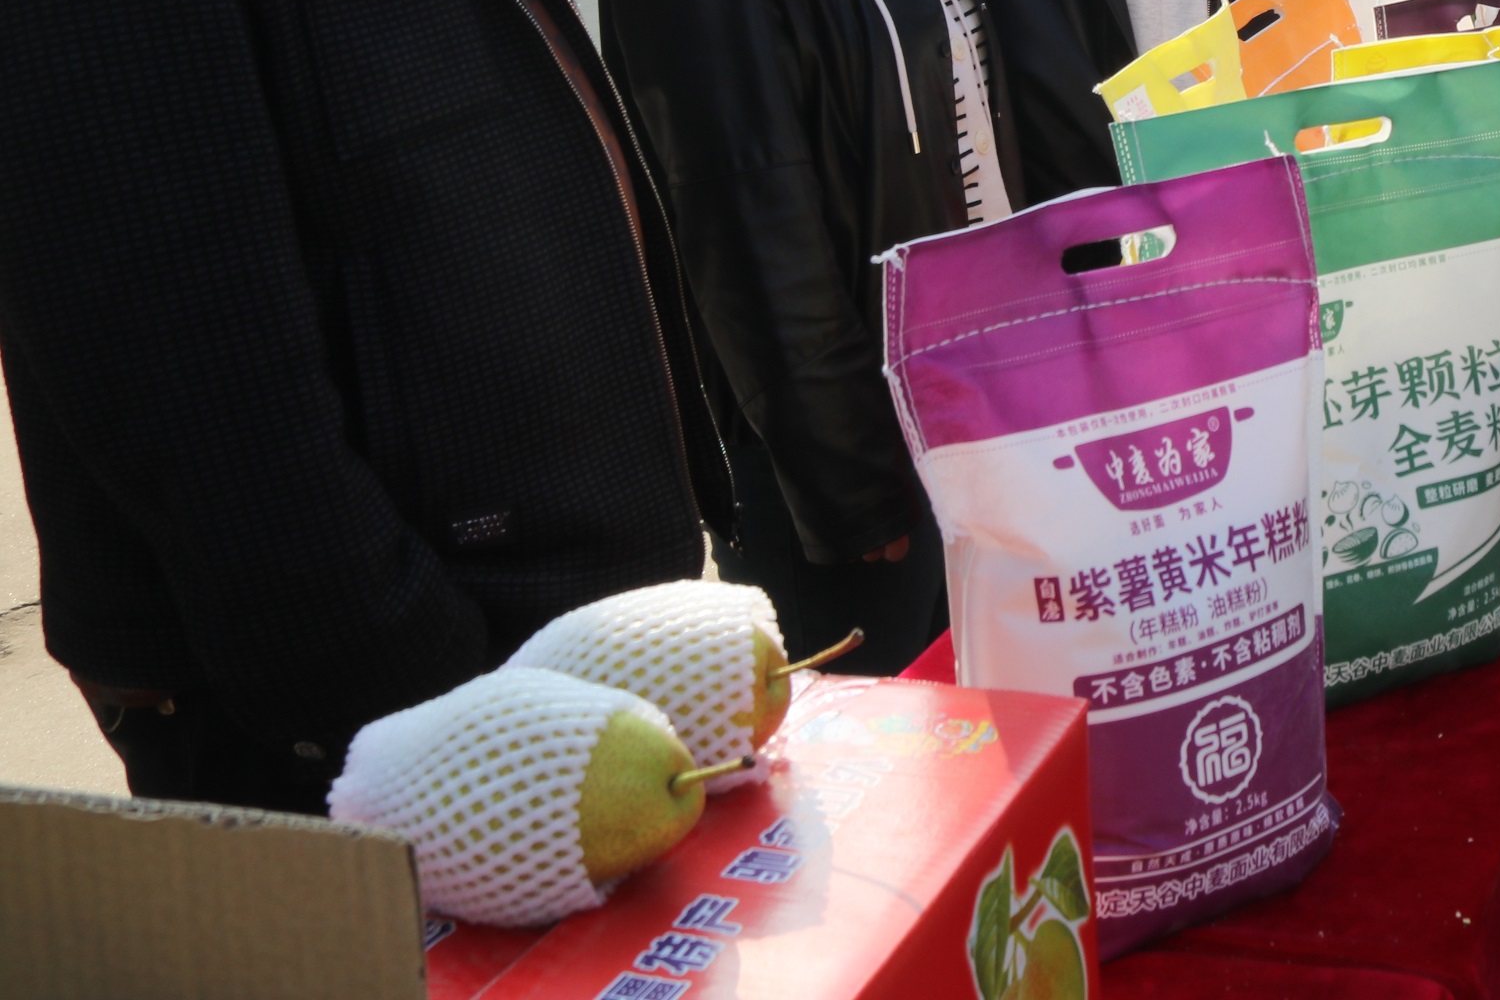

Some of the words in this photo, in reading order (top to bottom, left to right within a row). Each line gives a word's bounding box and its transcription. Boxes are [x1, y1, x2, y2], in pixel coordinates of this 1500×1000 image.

[1119, 467, 1219, 504] ZHONGMAIWEIJIA
[1130, 514, 1165, 536] 选好面
[1178, 497, 1223, 522] 为家人
[1069, 496, 1311, 622] 紫薯黄米年糕粉
